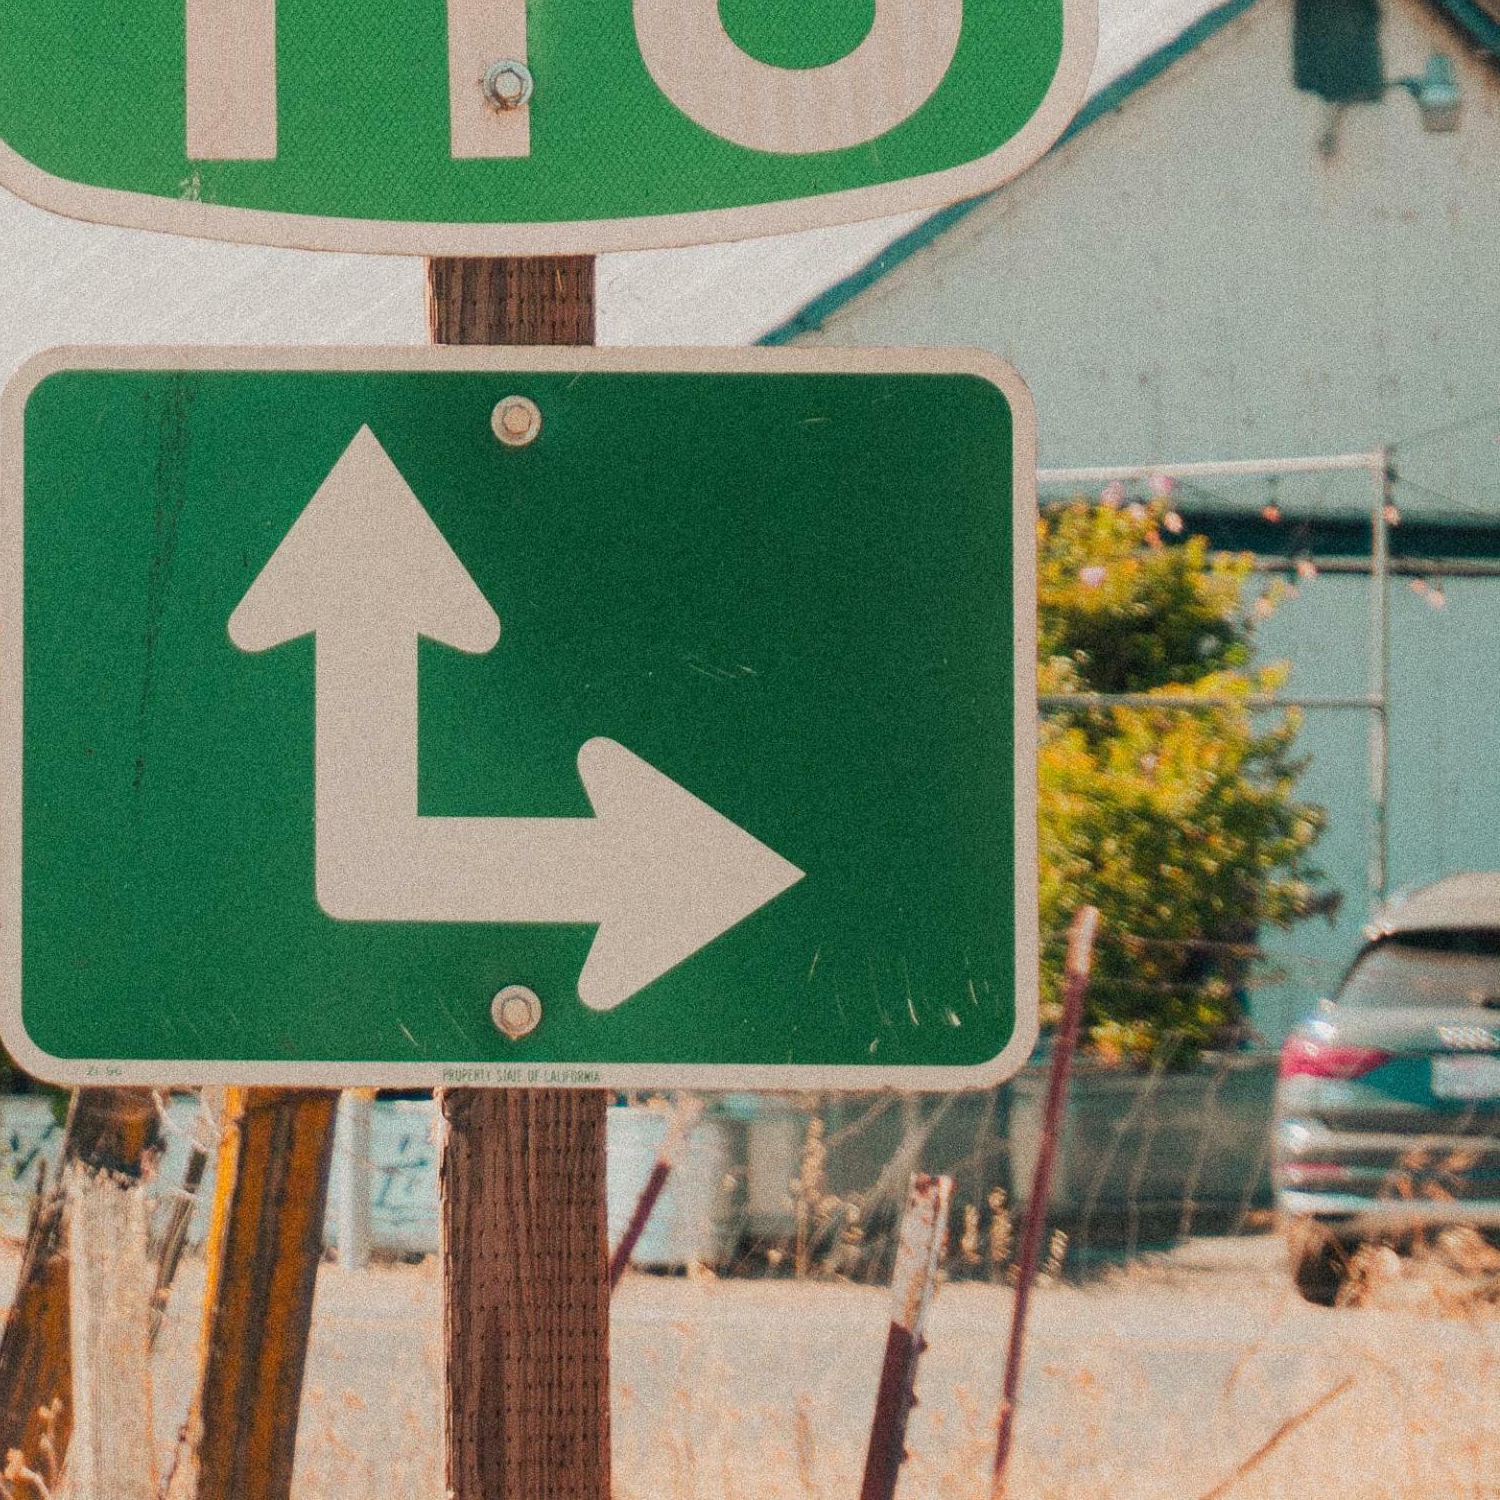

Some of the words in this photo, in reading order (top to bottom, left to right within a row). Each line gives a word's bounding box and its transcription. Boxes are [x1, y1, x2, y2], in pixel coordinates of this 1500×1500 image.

[443, 1068, 491, 1082] PROPERTY
[497, 1069, 522, 1082] STATE
[527, 1069, 540, 1083] OF
[544, 1069, 600, 1083] CALIFORNIA
